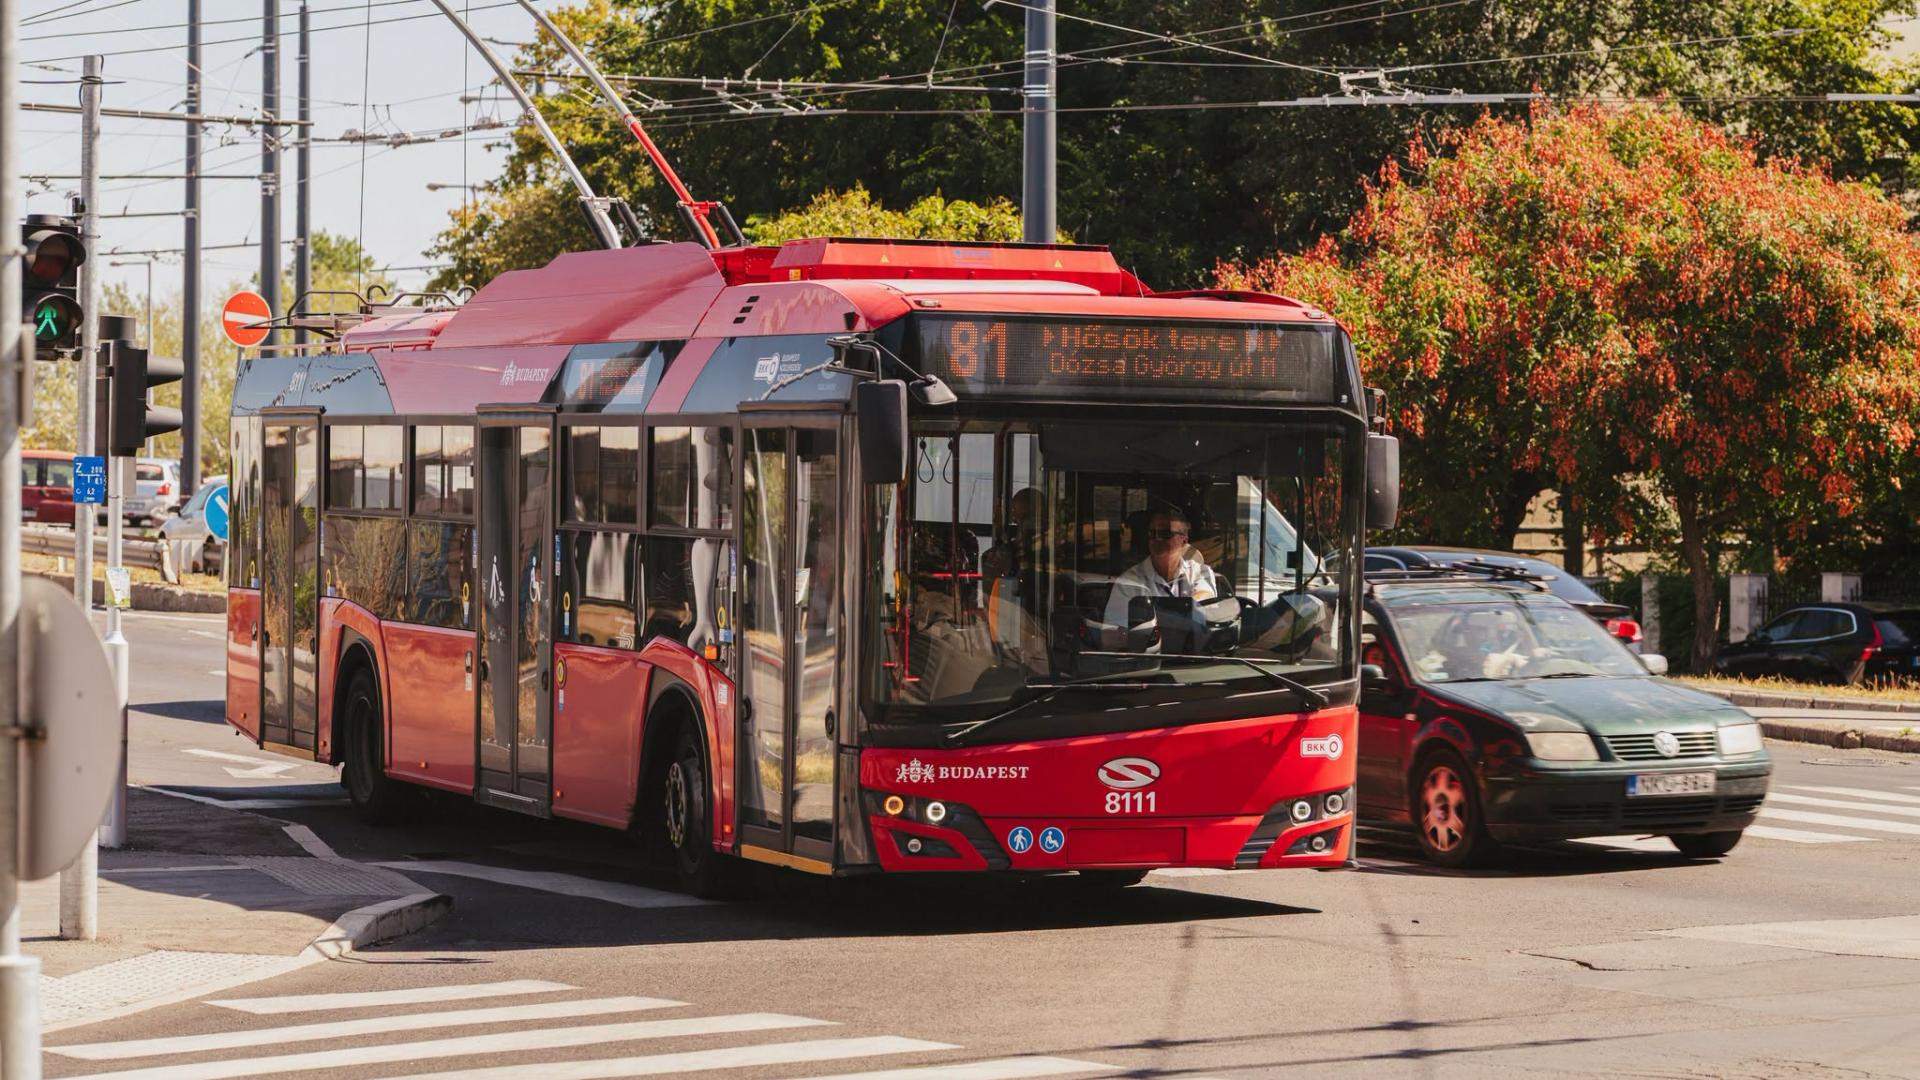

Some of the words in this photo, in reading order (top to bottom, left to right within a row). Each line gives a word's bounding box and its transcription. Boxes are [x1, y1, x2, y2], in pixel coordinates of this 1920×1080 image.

[952, 321, 1006, 377] 81
[1061, 325, 1159, 350] Hősök
[1169, 329, 1237, 351] tere
[1051, 352, 1126, 375] Dózsa
[1229, 353, 1253, 377] út
[75, 462, 83, 473] Z
[1307, 743, 1326, 752] BKK
[938, 766, 1030, 779] BUDAPEST
[1105, 791, 1156, 813] 8111
